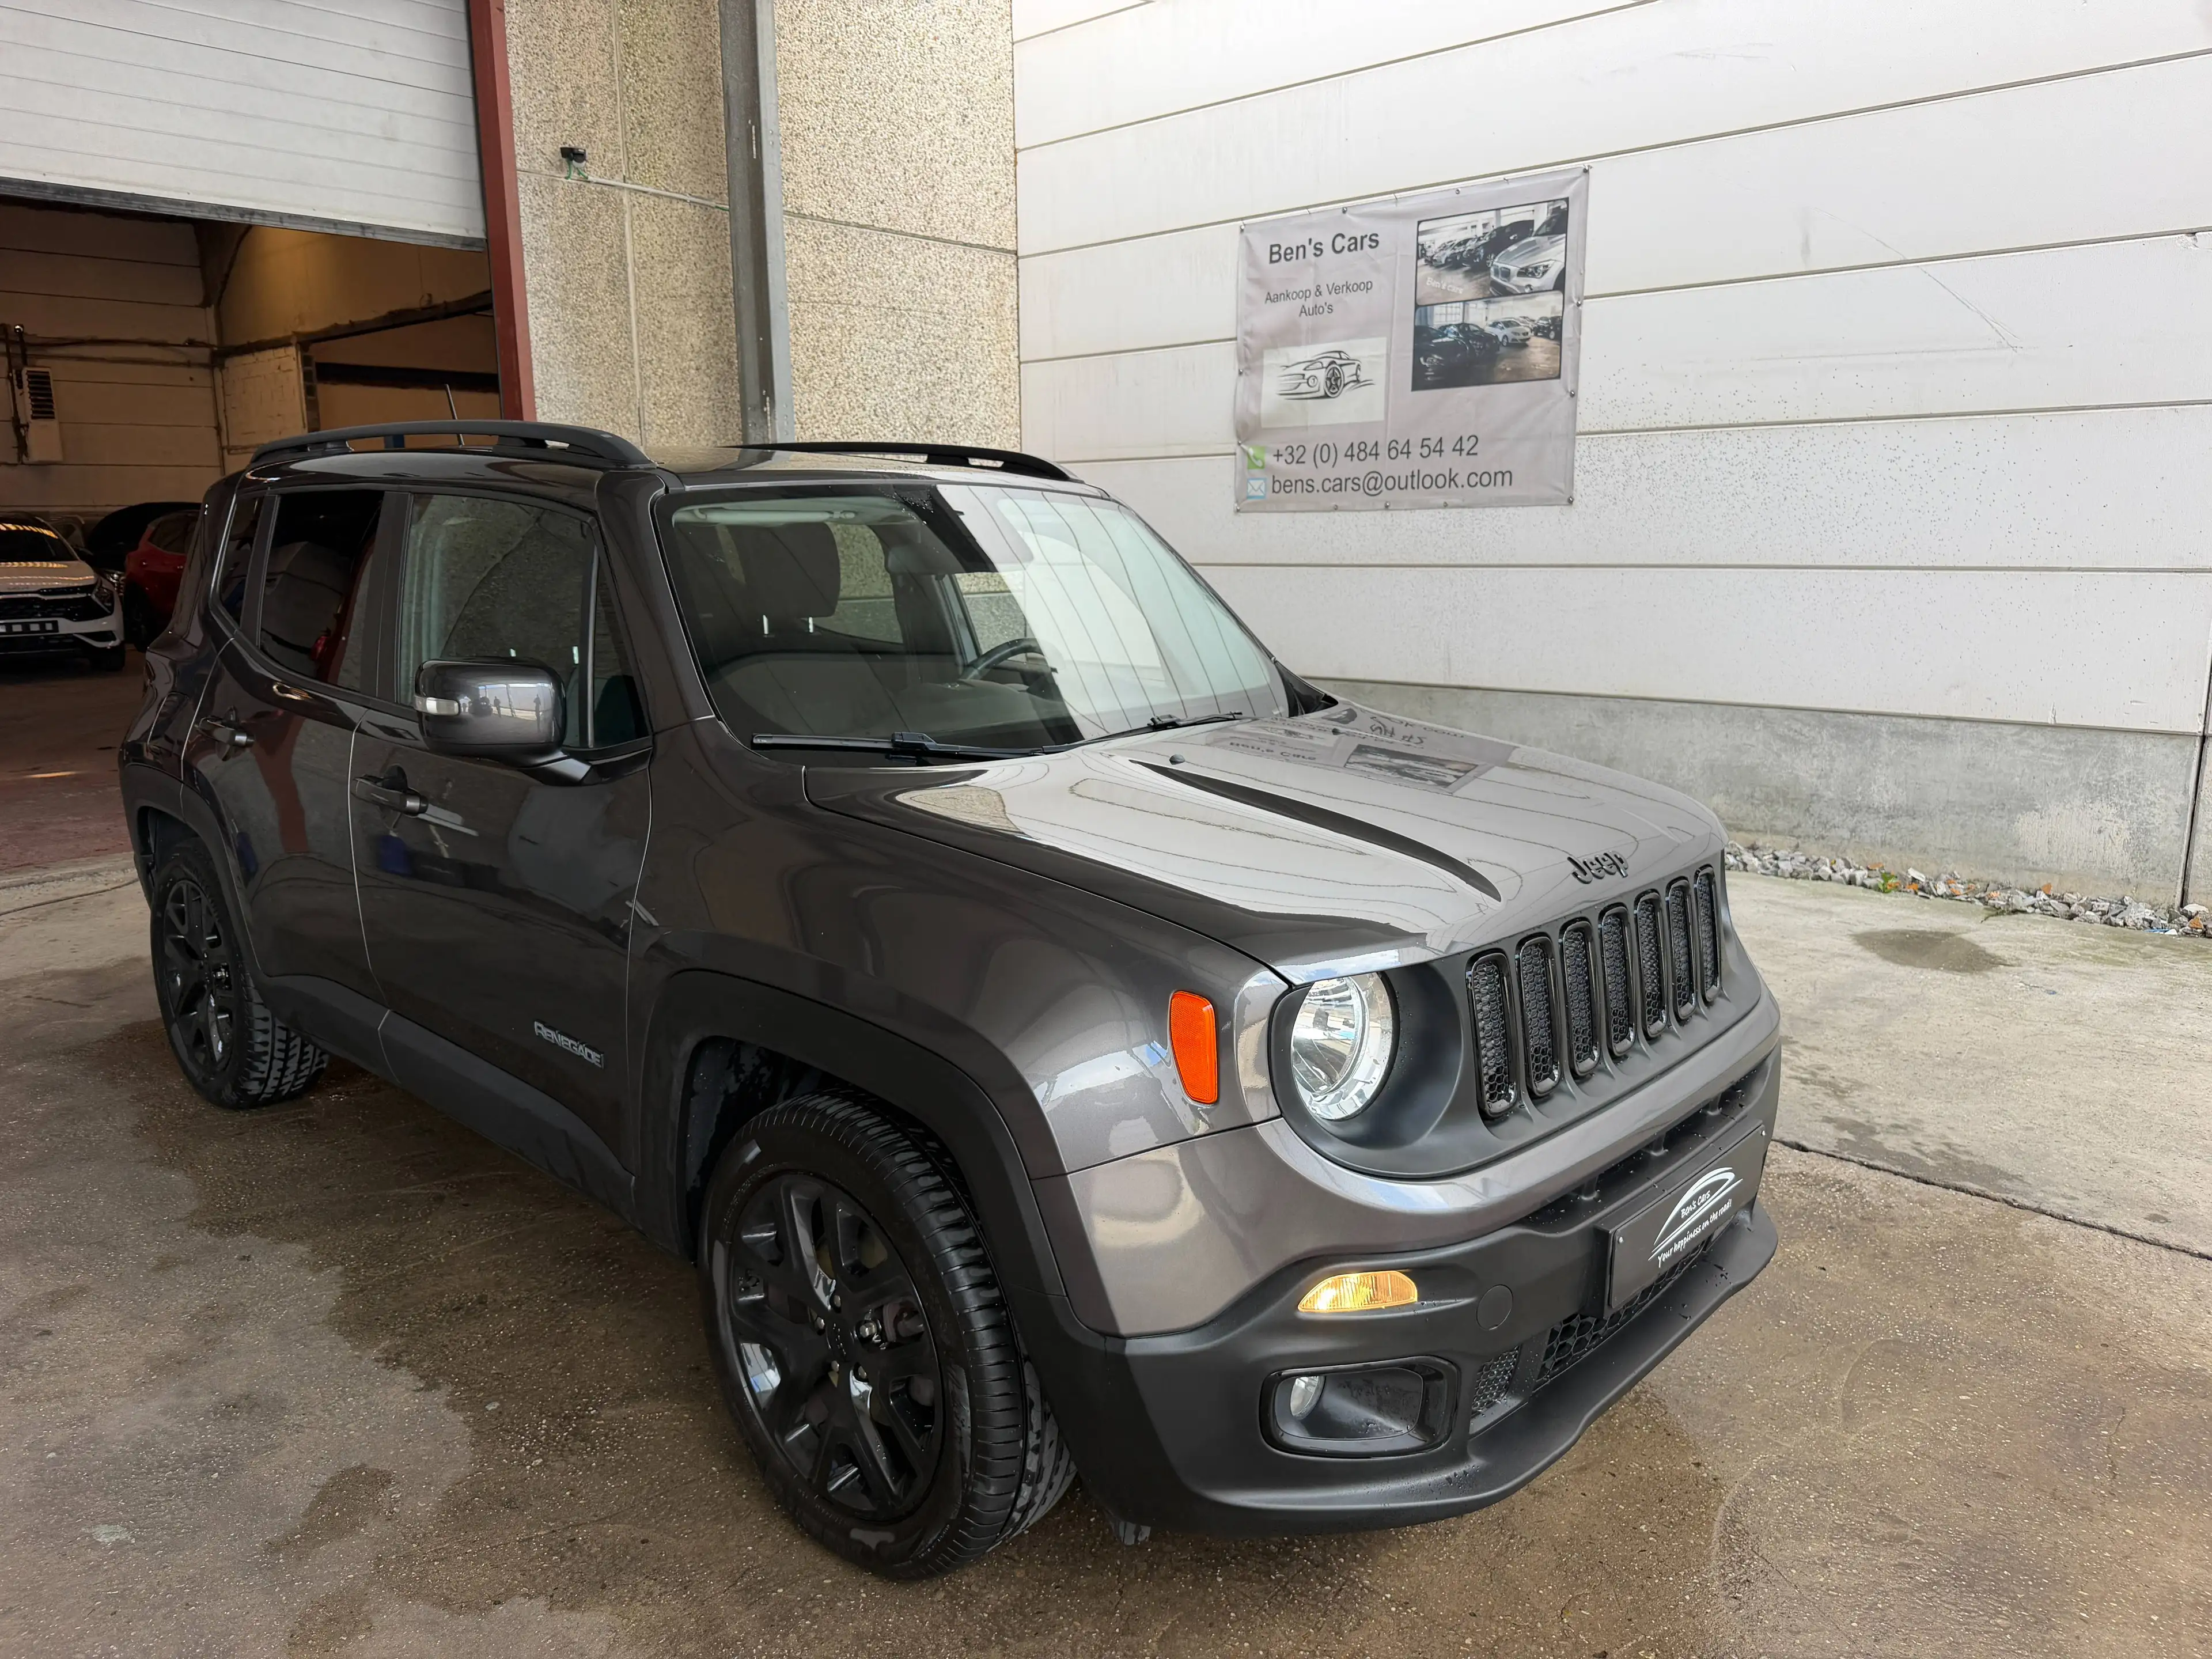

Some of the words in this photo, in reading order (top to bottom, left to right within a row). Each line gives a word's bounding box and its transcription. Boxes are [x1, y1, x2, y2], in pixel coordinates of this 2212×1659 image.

[1269, 237, 1323, 264] Ben's
[1331, 233, 1380, 255] Cars
[1264, 289, 1312, 304] Aankoop
[1315, 285, 1323, 297] &
[1326, 280, 1373, 295] Verkoop
[1298, 302, 1334, 317] Auto's
[1272, 444, 1306, 465] +32
[1313, 442, 1338, 469] (0)
[1344, 441, 1380, 462] 484
[1387, 439, 1412, 460] 64
[1419, 437, 1445, 459] 54
[1452, 434, 1479, 457] 42
[1271, 468, 1513, 497] bens.cars@outlook.com
[1567, 850, 1629, 885] Jeep
[534, 1020, 604, 1070] RENEGADE
[1680, 1200, 1696, 1219] Ben's
[1697, 1190, 1710, 1206] Cars
[1657, 1247, 1673, 1268] Your
[1673, 1224, 1702, 1252] happiness
[1702, 1219, 1710, 1230] on
[1710, 1211, 1718, 1224] the
[1718, 1198, 1732, 1217] road!
